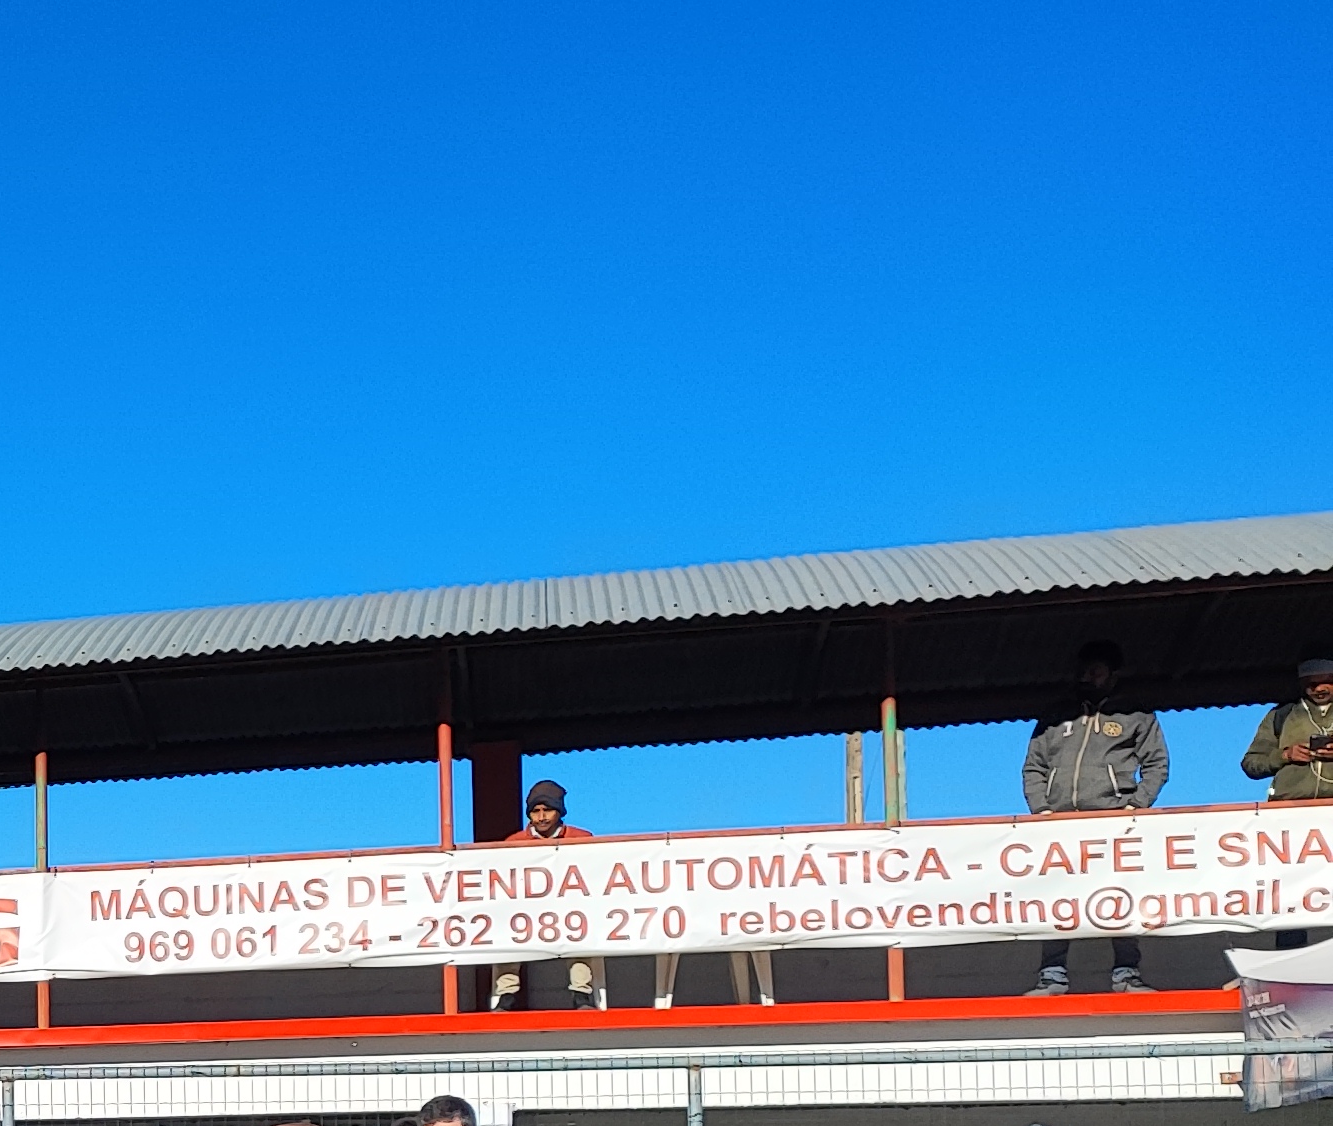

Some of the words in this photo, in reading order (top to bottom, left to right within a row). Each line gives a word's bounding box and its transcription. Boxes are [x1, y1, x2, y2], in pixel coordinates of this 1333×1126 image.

[90, 878, 329, 920] MÁQUINAS
[347, 874, 407, 904] DE
[424, 865, 591, 904] VENDA
[604, 844, 951, 896] AUTOMÁTICA
[999, 827, 1144, 877] CAFÉ
[1165, 835, 1197, 871] E
[124, 929, 194, 963] 969
[211, 925, 277, 958] 061
[298, 920, 372, 954] 234
[417, 914, 493, 948] 262
[510, 910, 588, 943] 989
[606, 906, 686, 940] 270
